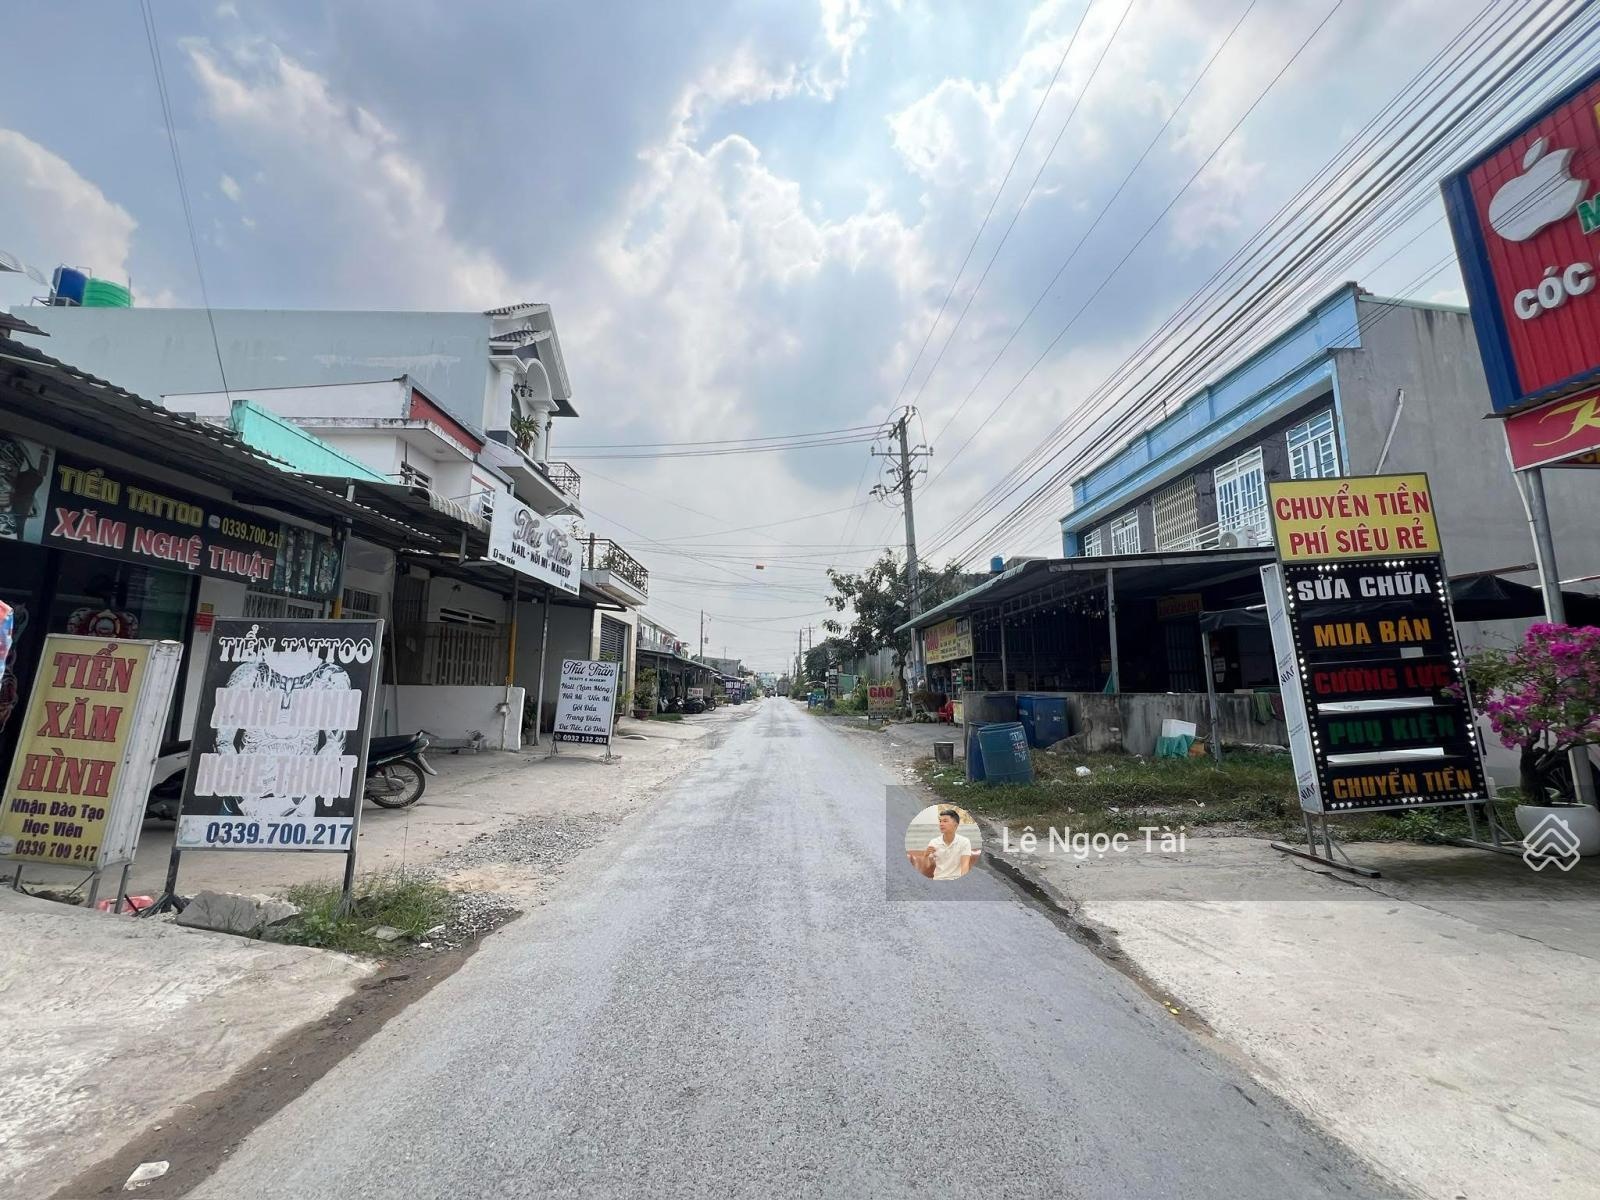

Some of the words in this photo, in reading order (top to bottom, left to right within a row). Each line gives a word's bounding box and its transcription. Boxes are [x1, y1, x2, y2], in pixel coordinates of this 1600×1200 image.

[1514, 264, 1595, 320] CÓC
[127, 486, 204, 528] TATTOO
[1275, 483, 1370, 520] CHUYỂN
[1374, 482, 1430, 516] TIỀN
[50, 507, 127, 549] XĂM
[132, 527, 202, 569] NGHỆ
[208, 545, 274, 583] THUẬT
[1289, 525, 1329, 555] PHÍ
[1335, 523, 1389, 553] SIÊU
[1396, 517, 1428, 550] RẺ
[512, 542, 526, 558] NAIL
[551, 562, 571, 579] MAKEUP
[1297, 574, 1351, 601] SỬA
[1359, 571, 1432, 597] CHỮA
[219, 624, 277, 664] TIỂN
[281, 637, 374, 664] TATTOO
[1313, 622, 1372, 647] MUA
[1379, 616, 1432, 643] BÁN
[52, 643, 137, 693] TIỂN
[563, 660, 586, 675] Thư
[588, 663, 615, 677] Trần
[37, 696, 123, 742] XĂM
[566, 713, 585, 722] Trang
[1328, 718, 1383, 747] PHỤ
[1391, 712, 1456, 744] KIỆN
[562, 734, 580, 742] 0932
[581, 735, 594, 743] 132
[594, 736, 607, 744] 201
[17, 747, 117, 797] HÌNH
[1333, 767, 1418, 799] CHUYỂN
[10, 798, 47, 817] Nhận
[49, 801, 77, 818] Đào
[80, 804, 105, 822] Tạo
[22, 818, 50, 837] Học
[53, 821, 83, 838] Viên
[206, 821, 353, 845] 0339.700.217
[15, 839, 46, 856] 0339
[48, 843, 72, 858] 700
[73, 844, 98, 861] 217
